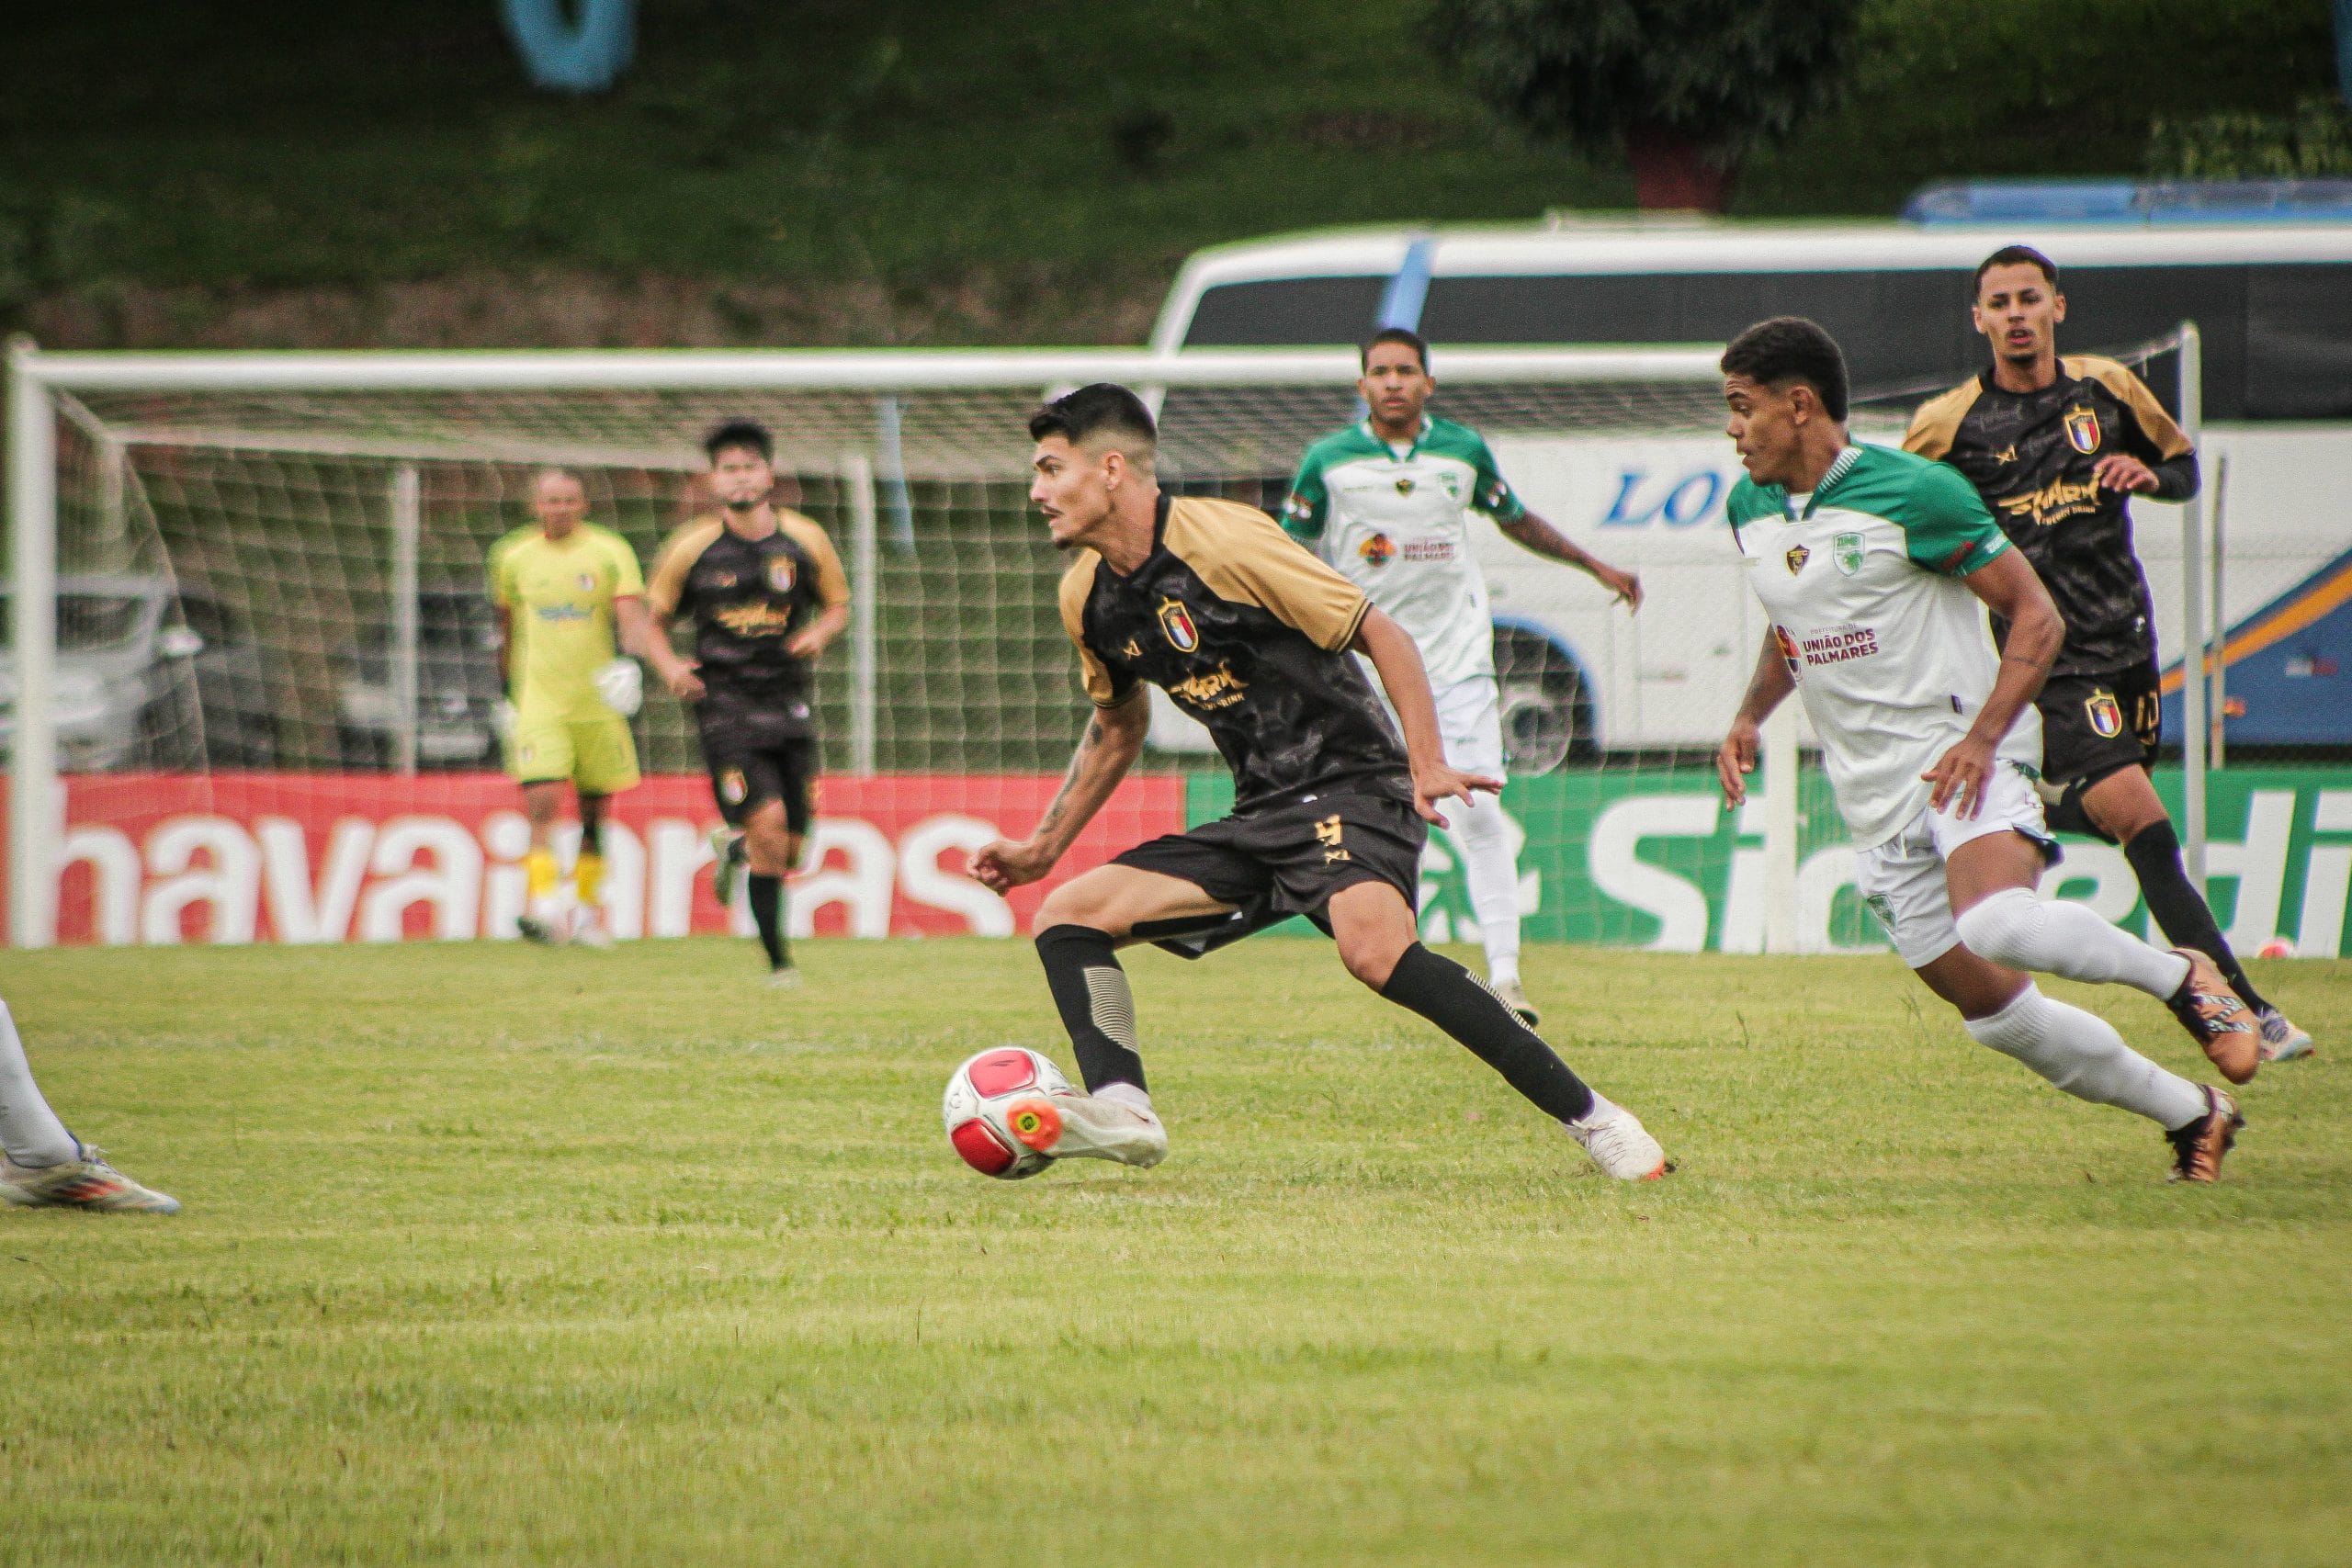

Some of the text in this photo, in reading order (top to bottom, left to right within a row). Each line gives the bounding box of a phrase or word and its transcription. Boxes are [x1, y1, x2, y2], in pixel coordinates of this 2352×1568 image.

[1803, 627, 1875, 653] UNIÃO DOS
[1806, 641, 1879, 666] PALMARES
[1589, 791, 2352, 957] Sicedi
